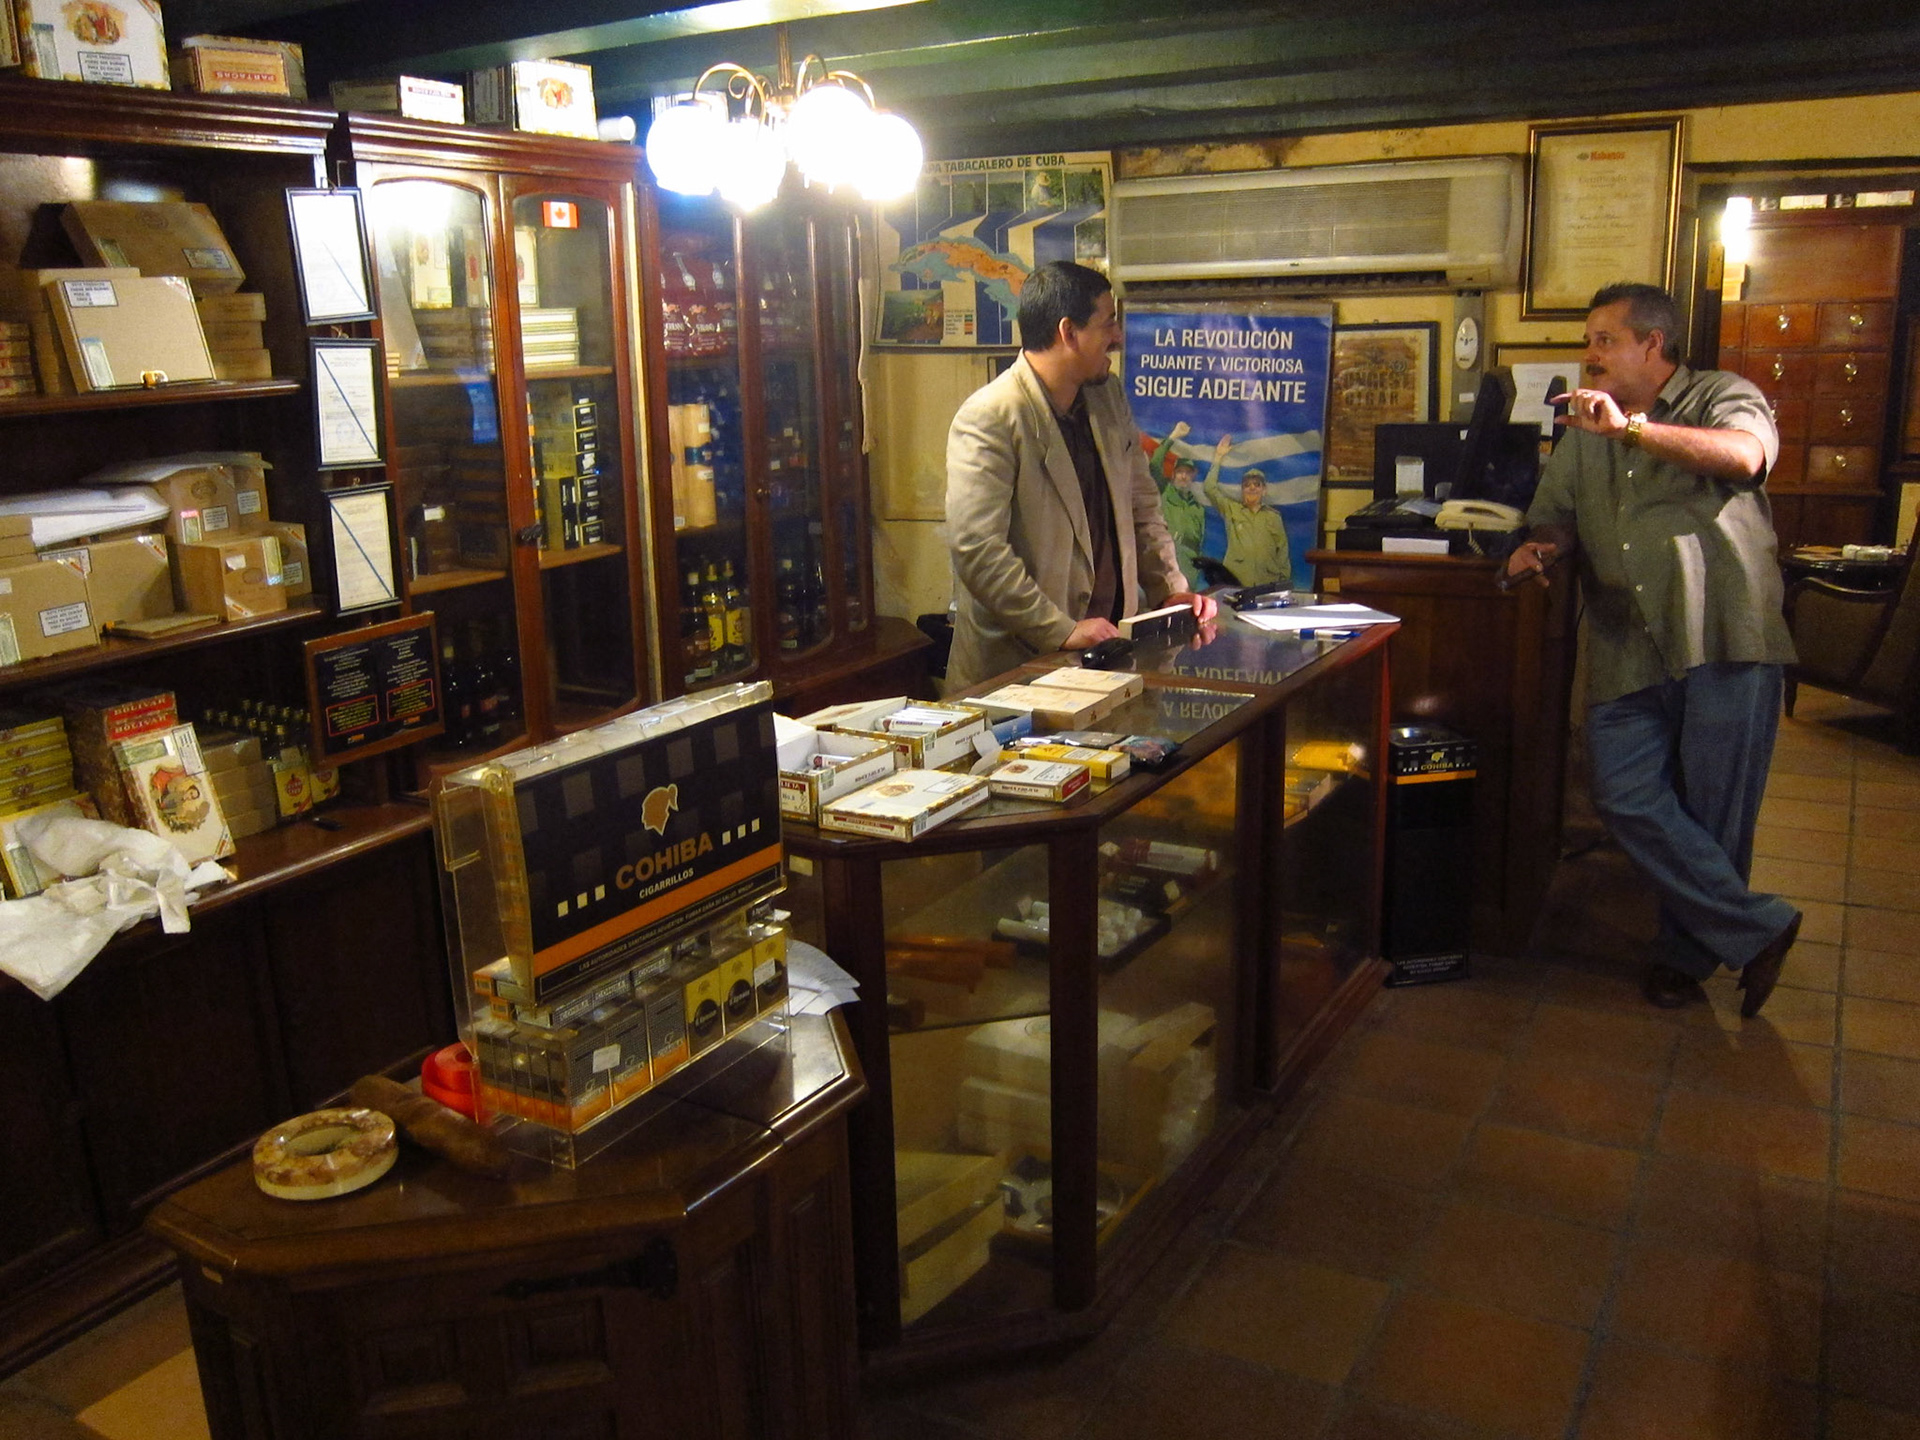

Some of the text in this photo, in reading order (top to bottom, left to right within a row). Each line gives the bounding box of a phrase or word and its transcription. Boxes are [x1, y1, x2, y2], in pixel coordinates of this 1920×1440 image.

[216, 71, 276, 82] PARTAGAS
[944, 157, 1014, 174] TABACALERO
[1017, 155, 1032, 168] DE
[1035, 154, 1067, 168] CUBA
[1155, 327, 1293, 350] LA REVOLUCIÓN
[1140, 354, 1304, 374] PUJANTE Y VICTORIOSA
[1134, 376, 1307, 404] SIGUE ADELANTE
[113, 697, 167, 716] BOLIVAR
[114, 715, 168, 734] BOLIVAR
[1420, 761, 1454, 771] COHIBA
[615, 831, 714, 890] COHIBA
[638, 867, 695, 900] CIGARRILLOS
